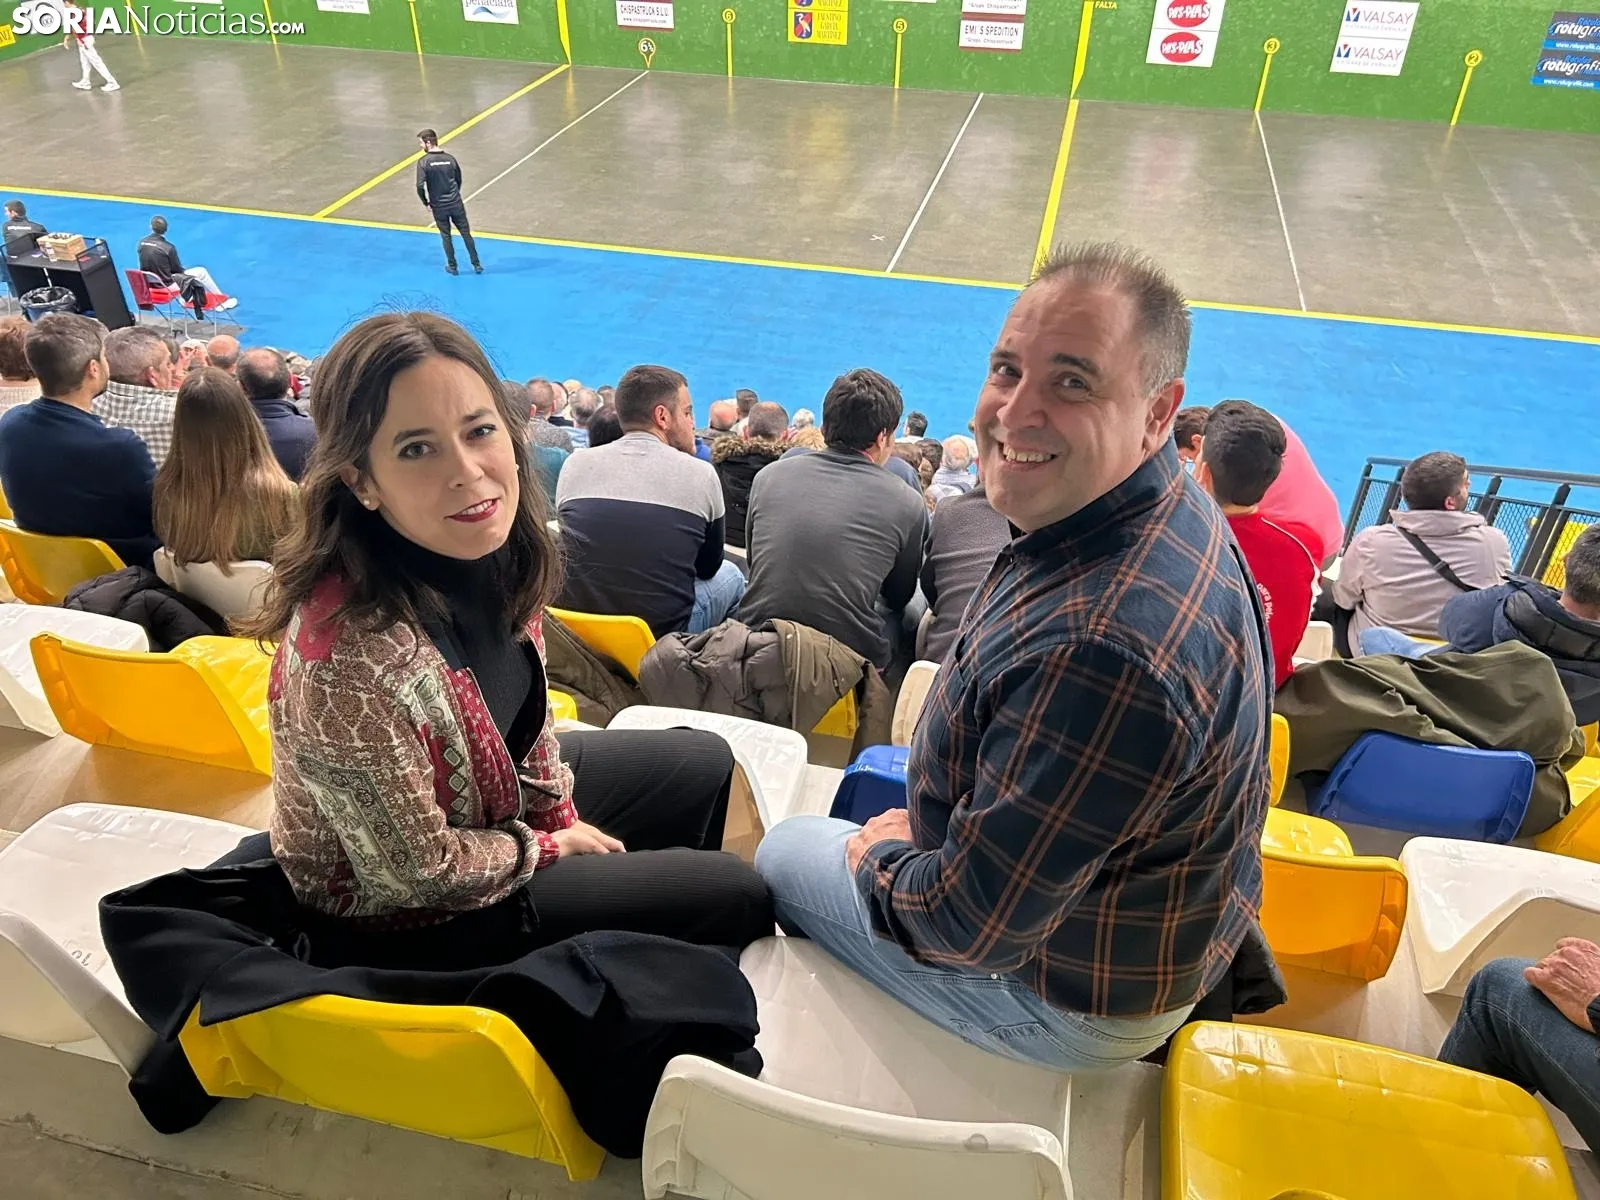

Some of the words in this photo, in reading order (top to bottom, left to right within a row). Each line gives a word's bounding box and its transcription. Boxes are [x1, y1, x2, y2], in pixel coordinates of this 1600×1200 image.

[1095, 1, 1117, 9] FALTA
[1363, 10, 1414, 25] VALSAY
[985, 26, 1019, 37] SPEDITION
[1353, 47, 1404, 61] VALSAY
[1542, 60, 1600, 76] rotugrafi
[1256, 583, 1272, 601] para
